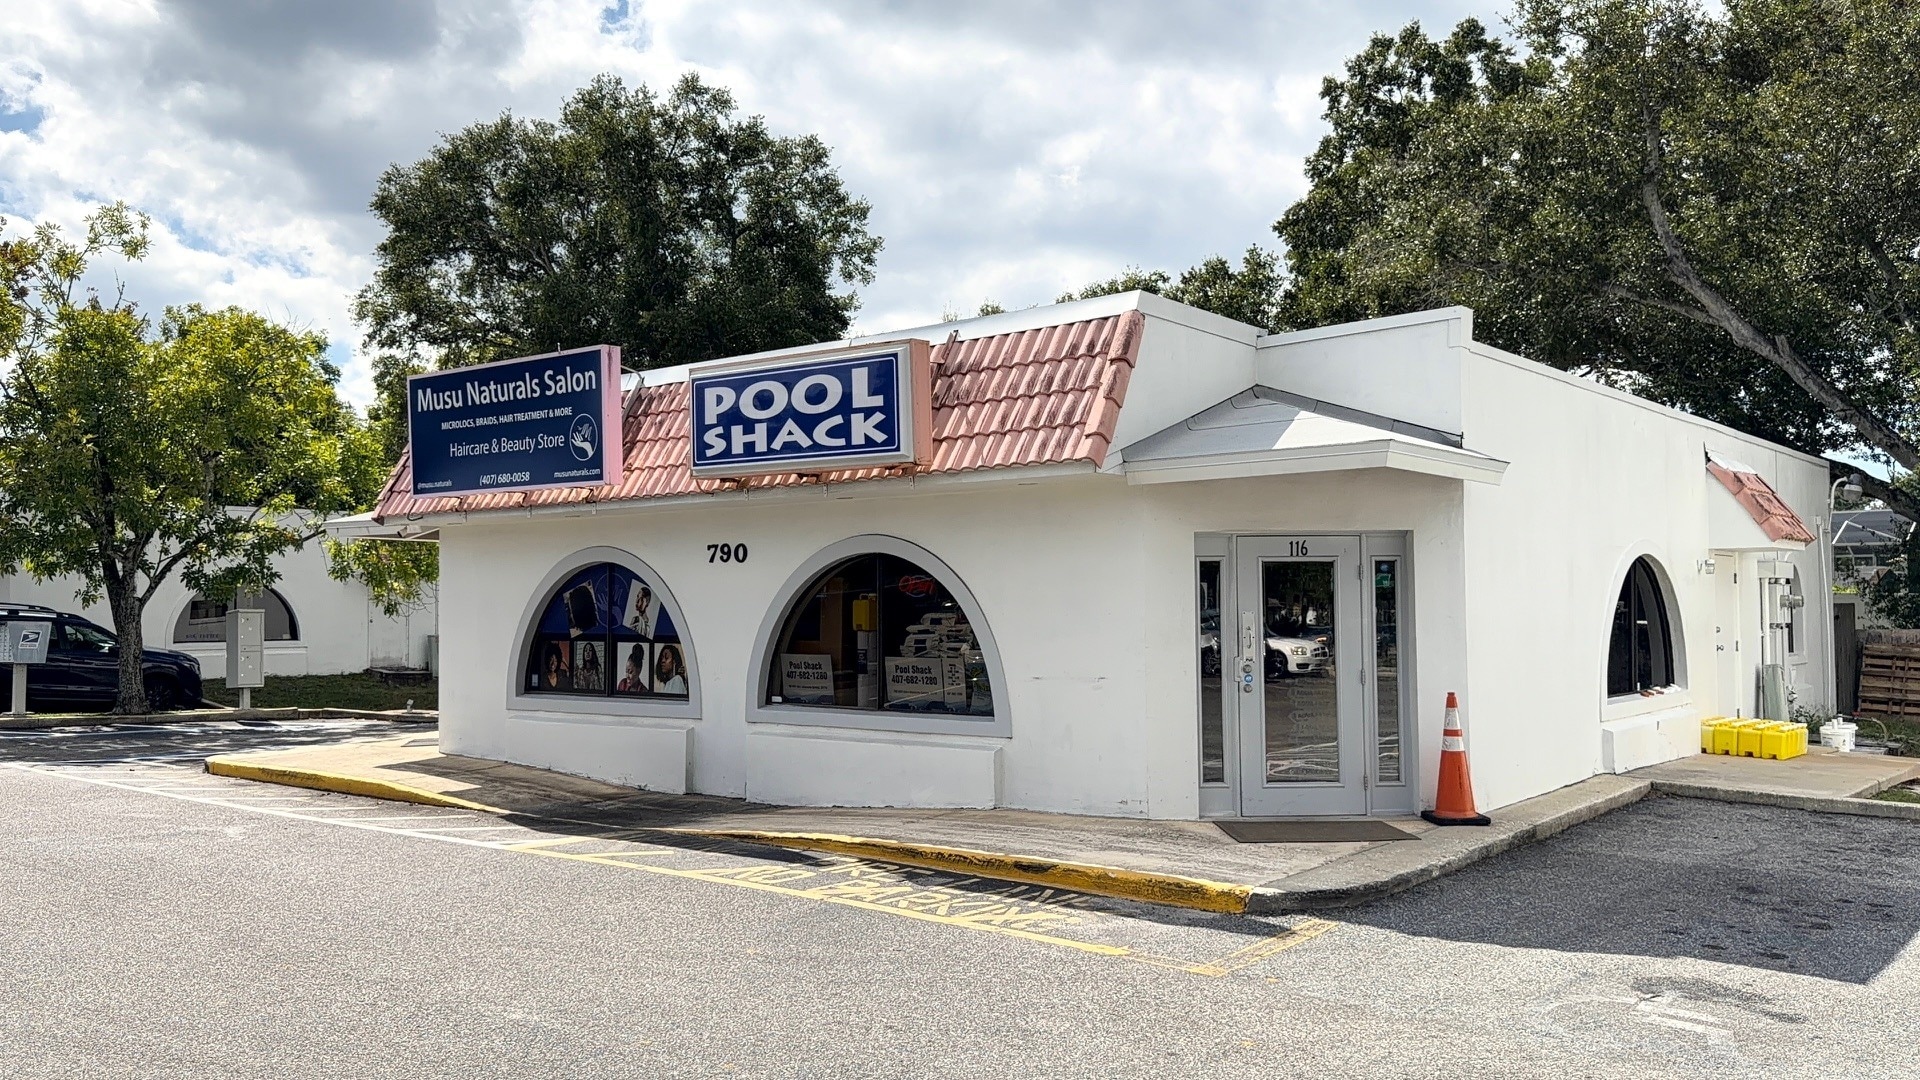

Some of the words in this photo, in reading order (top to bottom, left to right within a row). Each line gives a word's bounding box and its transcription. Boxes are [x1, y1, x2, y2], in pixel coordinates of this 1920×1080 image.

[417, 388, 462, 412] Musu
[466, 371, 540, 406] Naturals
[544, 366, 596, 396] Salon
[704, 366, 884, 425] POOL
[441, 418, 475, 430] MICROLOCS,
[476, 415, 498, 427] BRAIDS,
[499, 413, 514, 424] HAIR
[514, 409, 548, 422] TREATMENT
[548, 408, 554, 418] &
[554, 406, 573, 417] MORE
[703, 411, 889, 458] SHACK
[449, 440, 489, 458] Haircare
[491, 438, 499, 453] &
[501, 435, 536, 454] Beauty
[537, 432, 565, 448] Store
[479, 473, 497, 487] (407)
[497, 471, 530, 485] 680-0058
[707, 543, 748, 563] 790
[1289, 540, 1308, 557] 116
[789, 661, 803, 670] Pool
[803, 661, 823, 671] Shack
[894, 664, 911, 674] Pool
[911, 664, 933, 676] Shack
[891, 674, 938, 686] 407-682-1280
